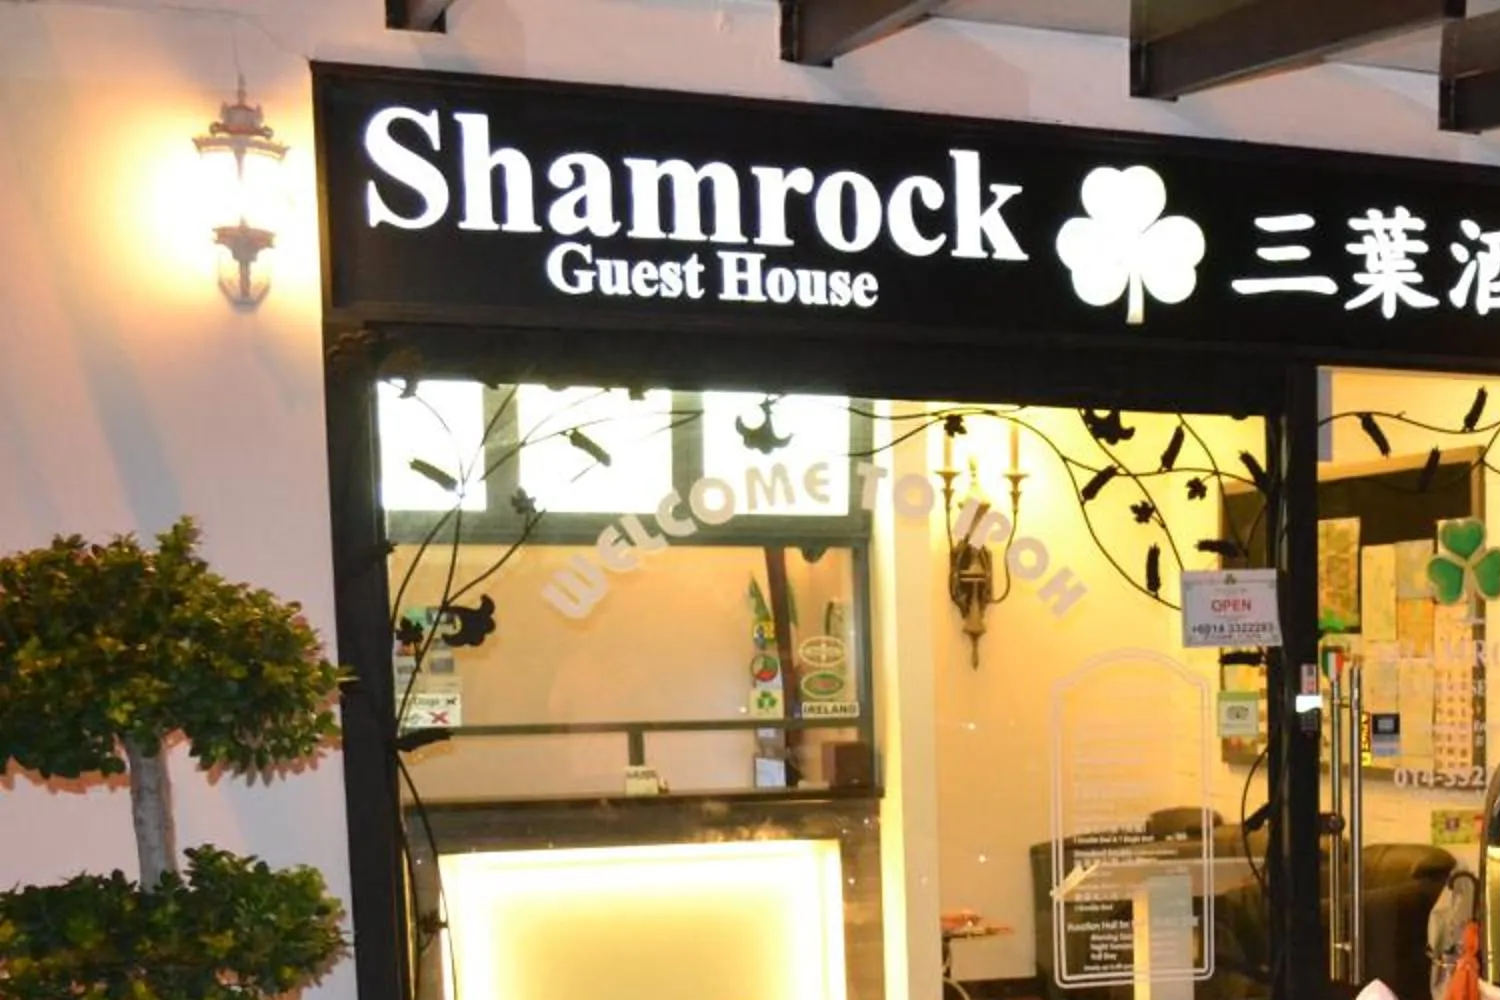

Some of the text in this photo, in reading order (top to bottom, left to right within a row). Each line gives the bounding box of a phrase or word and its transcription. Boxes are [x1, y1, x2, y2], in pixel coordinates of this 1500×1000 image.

[364, 106, 1029, 261] Shamrock
[546, 241, 879, 308] Guest House
[541, 461, 1089, 620] WELCOME TO IPOH
[1211, 598, 1252, 612] OPEN
[803, 702, 857, 715] IRELAND
[1393, 766, 1493, 787] 014-332
